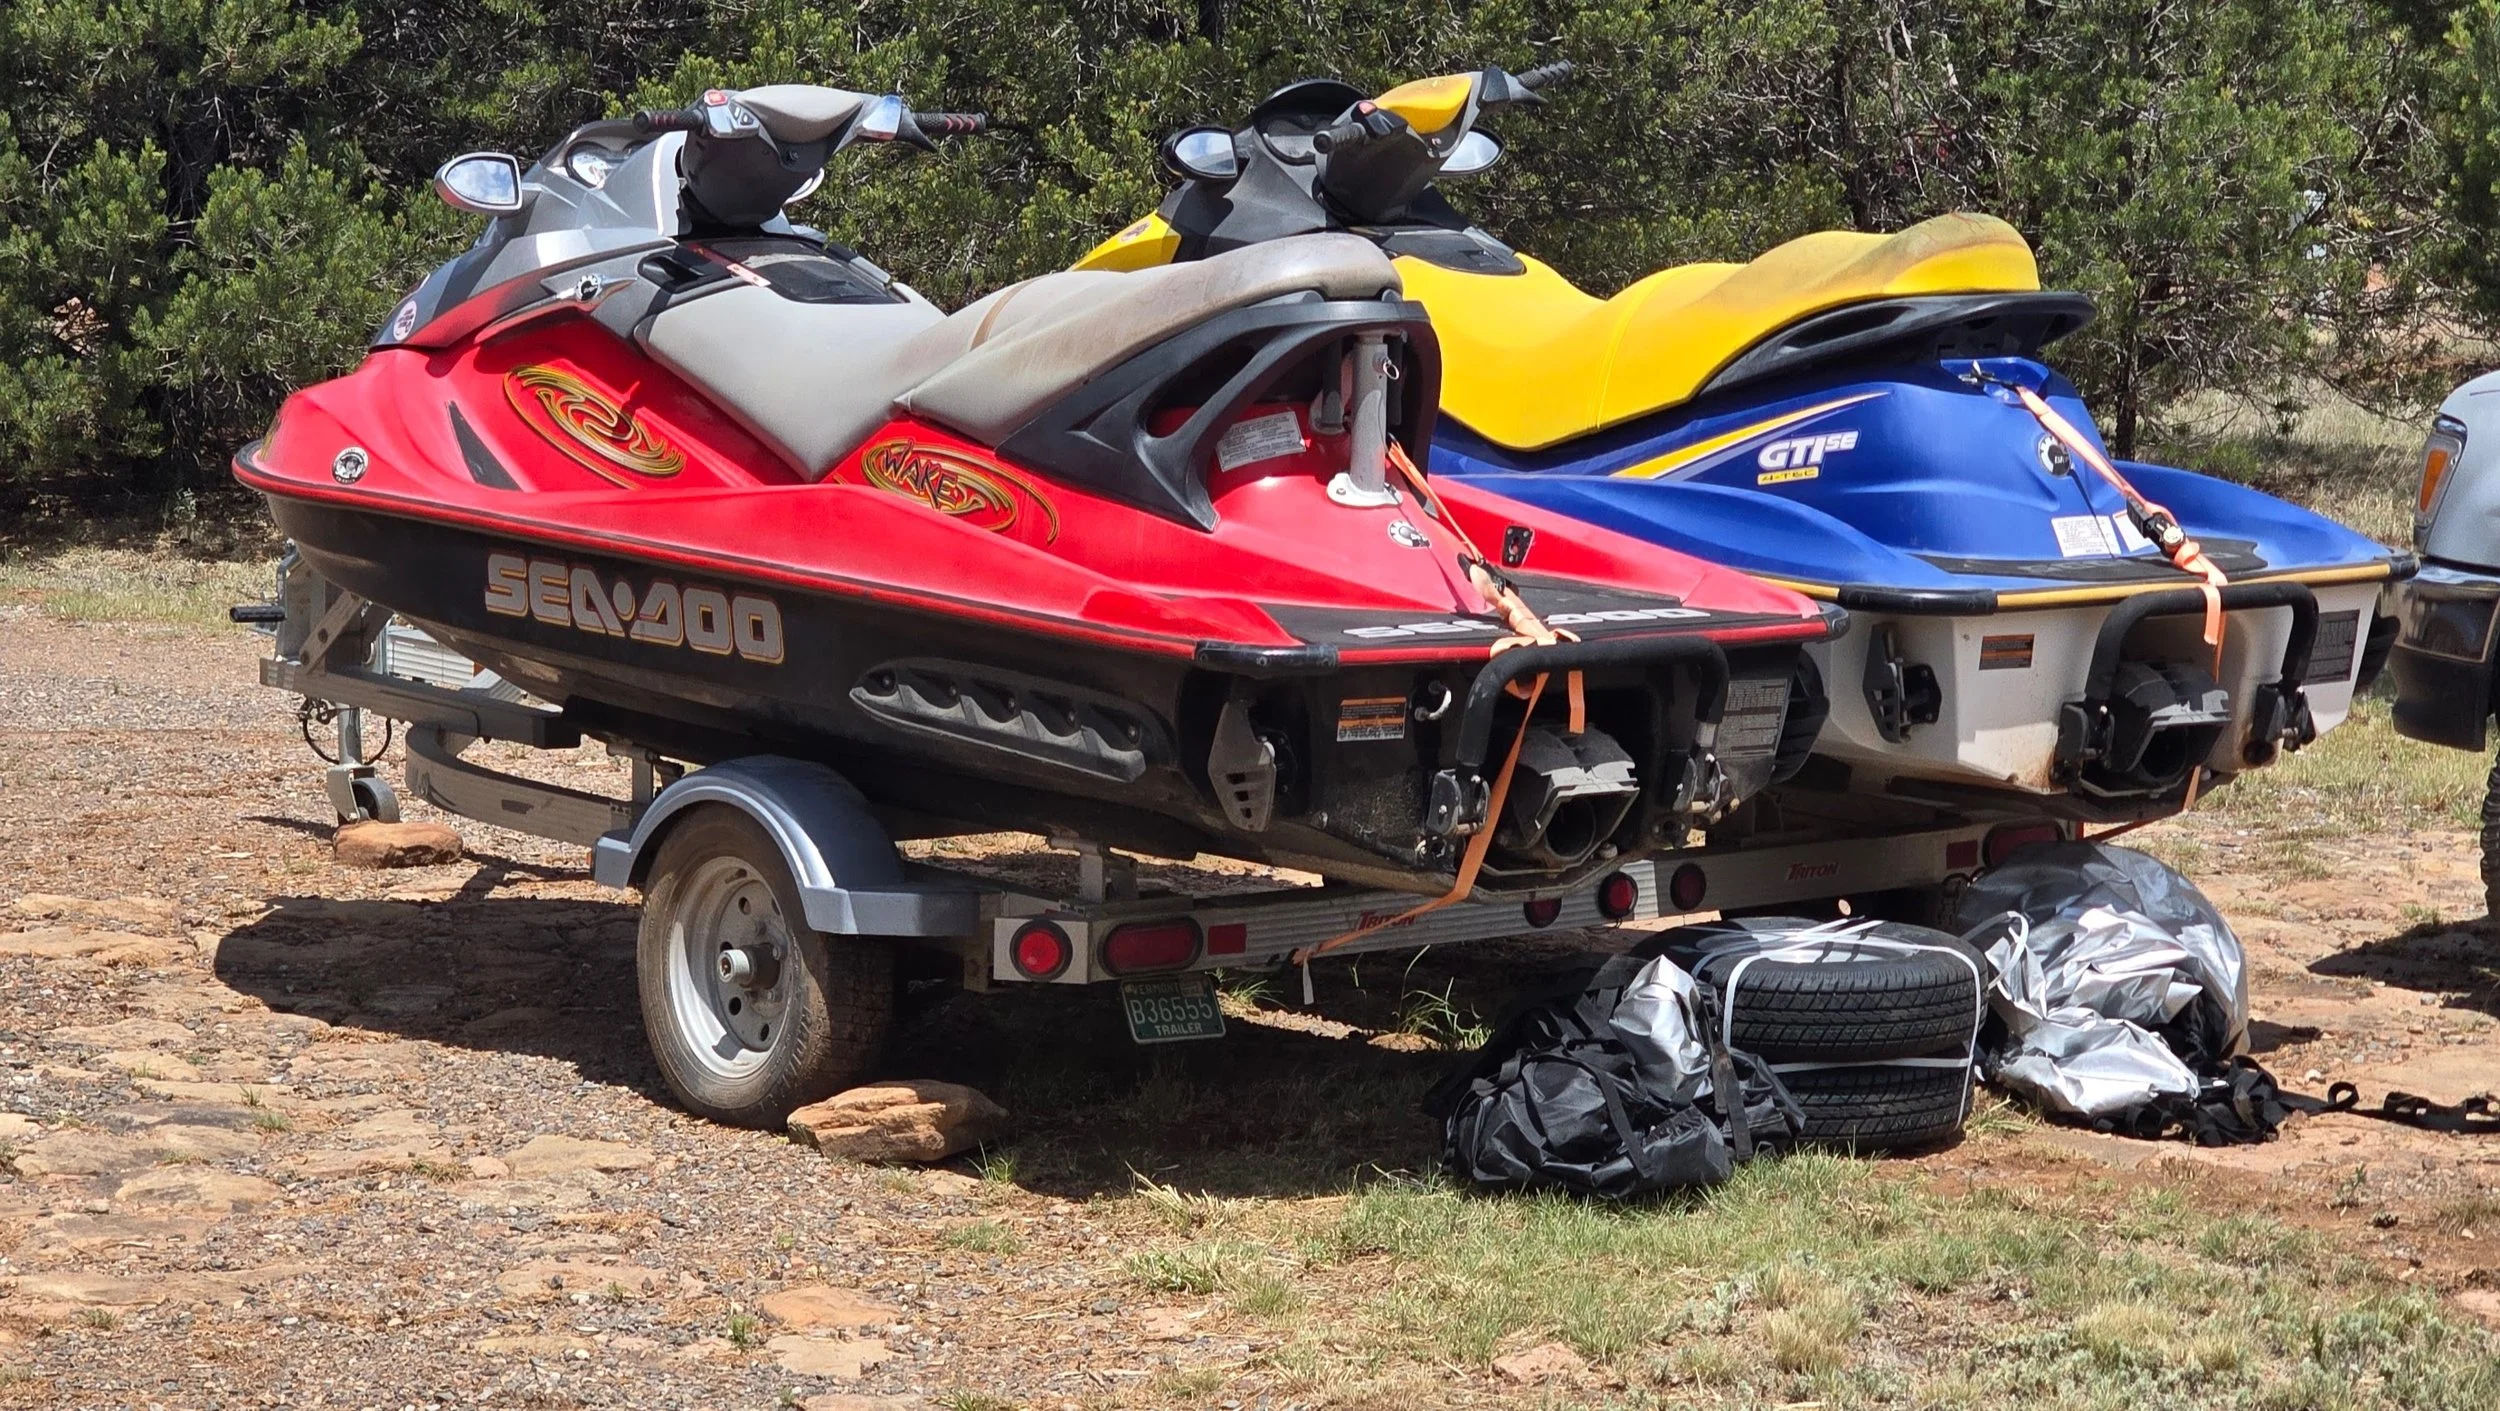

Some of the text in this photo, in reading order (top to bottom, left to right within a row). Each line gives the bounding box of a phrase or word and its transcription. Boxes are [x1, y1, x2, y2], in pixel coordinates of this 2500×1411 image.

[1757, 433, 1826, 470] GTI
[881, 440, 958, 511] WAKE
[1130, 997, 1213, 1024] B36555
[1154, 1022, 1203, 1037] TRAILER
